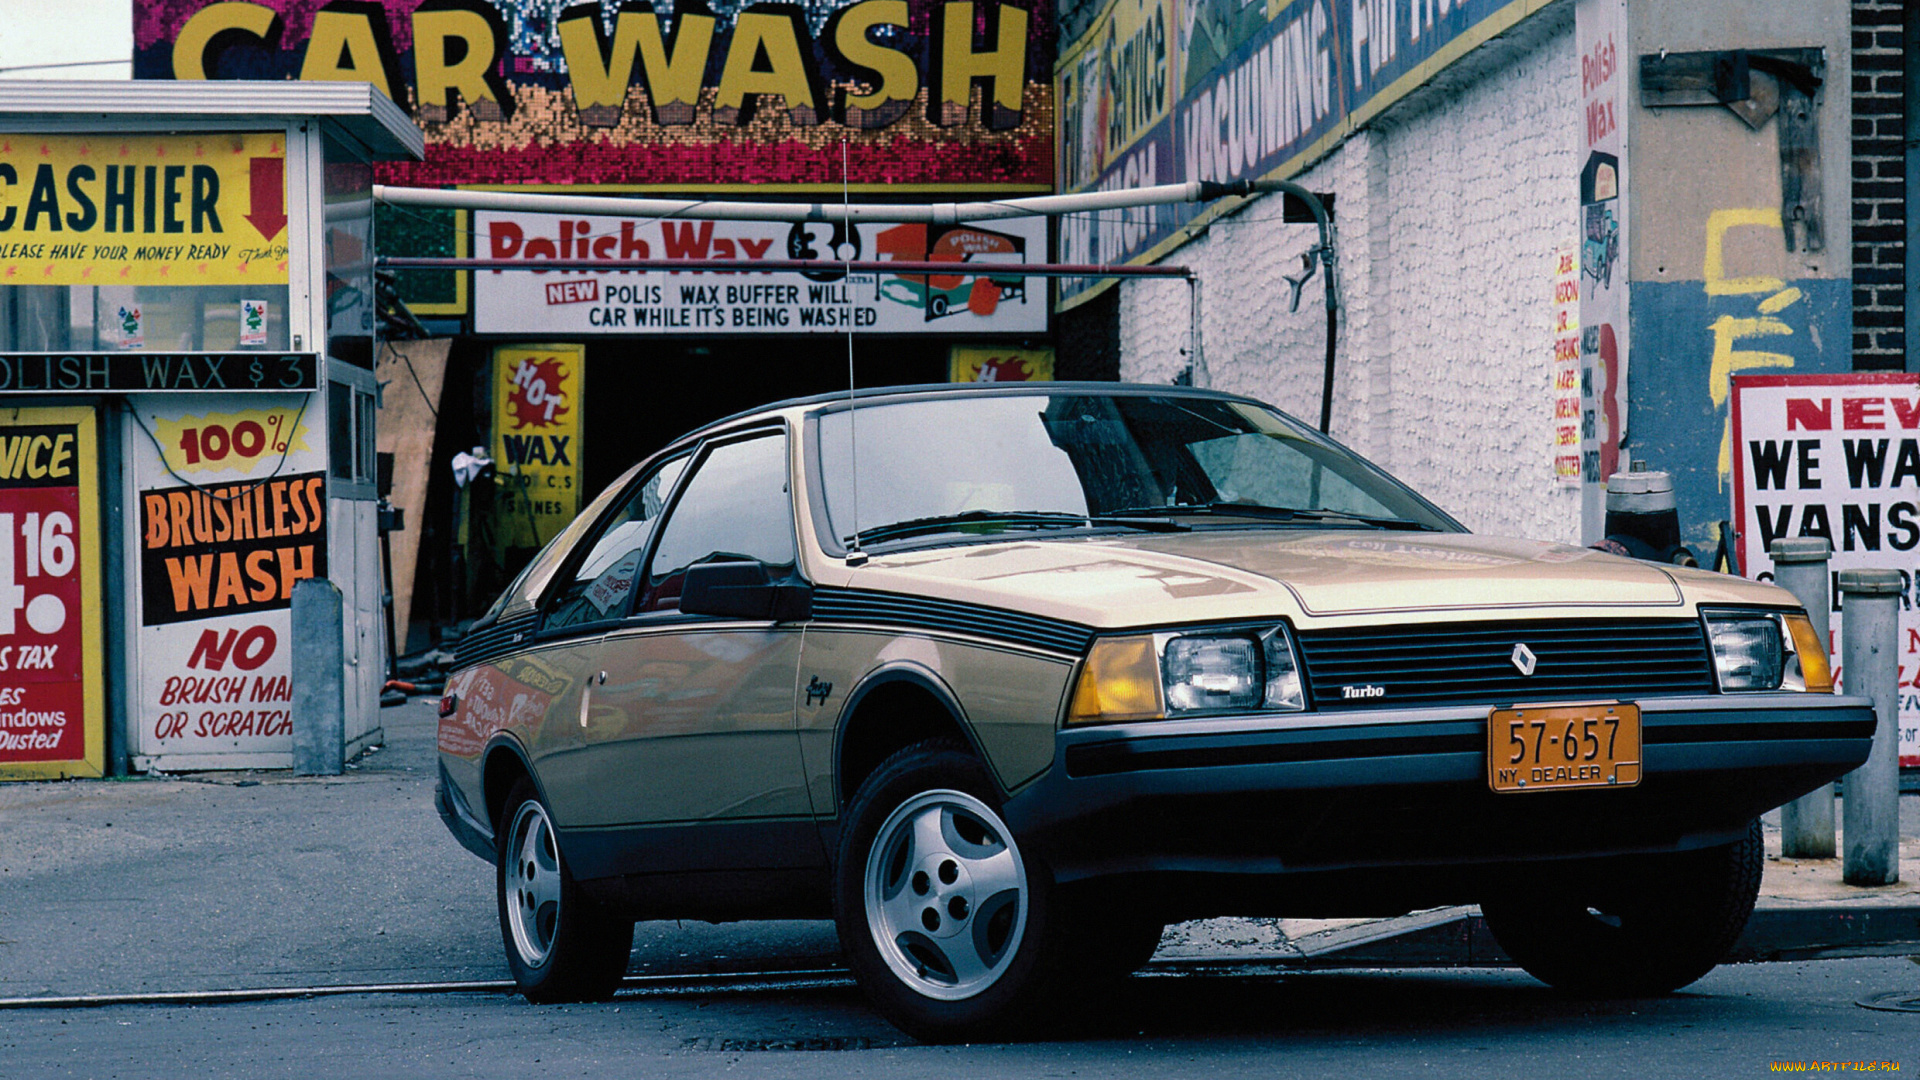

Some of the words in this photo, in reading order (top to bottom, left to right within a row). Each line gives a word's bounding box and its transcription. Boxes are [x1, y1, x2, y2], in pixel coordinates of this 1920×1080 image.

[172, 0, 498, 121] CAR
[557, 0, 1027, 130] WASH
[1582, 33, 1617, 99] Polish
[1183, 0, 1329, 184] VACUUMING
[1586, 101, 1616, 147] Wax
[0, 163, 224, 234] CASHIER
[1098, 140, 1156, 271] WASH
[0, 243, 46, 259] LEASE
[50, 244, 86, 260] HAVE
[92, 244, 128, 260] YOUR
[133, 245, 184, 261] MONEY
[186, 244, 231, 260] READY
[489, 220, 650, 275] Polish
[661, 221, 774, 275] Wax
[548, 281, 596, 304] NEW
[589, 308, 627, 327] CAR
[634, 308, 691, 327] WHILE
[696, 305, 725, 327] IT'S
[732, 308, 790, 327] BEING
[799, 308, 877, 327] WASHED
[605, 285, 662, 304] POLIS
[680, 285, 721, 305] WAX
[727, 285, 798, 304] BUFFER
[808, 285, 852, 304] WILL
[142, 357, 227, 389] WAX
[514, 360, 562, 420] HOT
[180, 414, 287, 465] 100%
[503, 435, 571, 466] WAX
[1749, 439, 1822, 490] WE
[145, 478, 322, 549] BRUSHLESS
[1756, 501, 1920, 553] VANS
[165, 545, 314, 613] WASH
[16, 644, 58, 670] TAX
[186, 624, 278, 672] NO
[159, 675, 248, 706] BRUSH
[1342, 685, 1385, 699] Turbo
[0, 729, 64, 751] Dusted
[155, 711, 188, 739] OR
[194, 710, 293, 738] SCRATCH
[1508, 716, 1620, 764] 57-657
[1499, 767, 1518, 783] NY
[1531, 764, 1601, 783] DEALER
